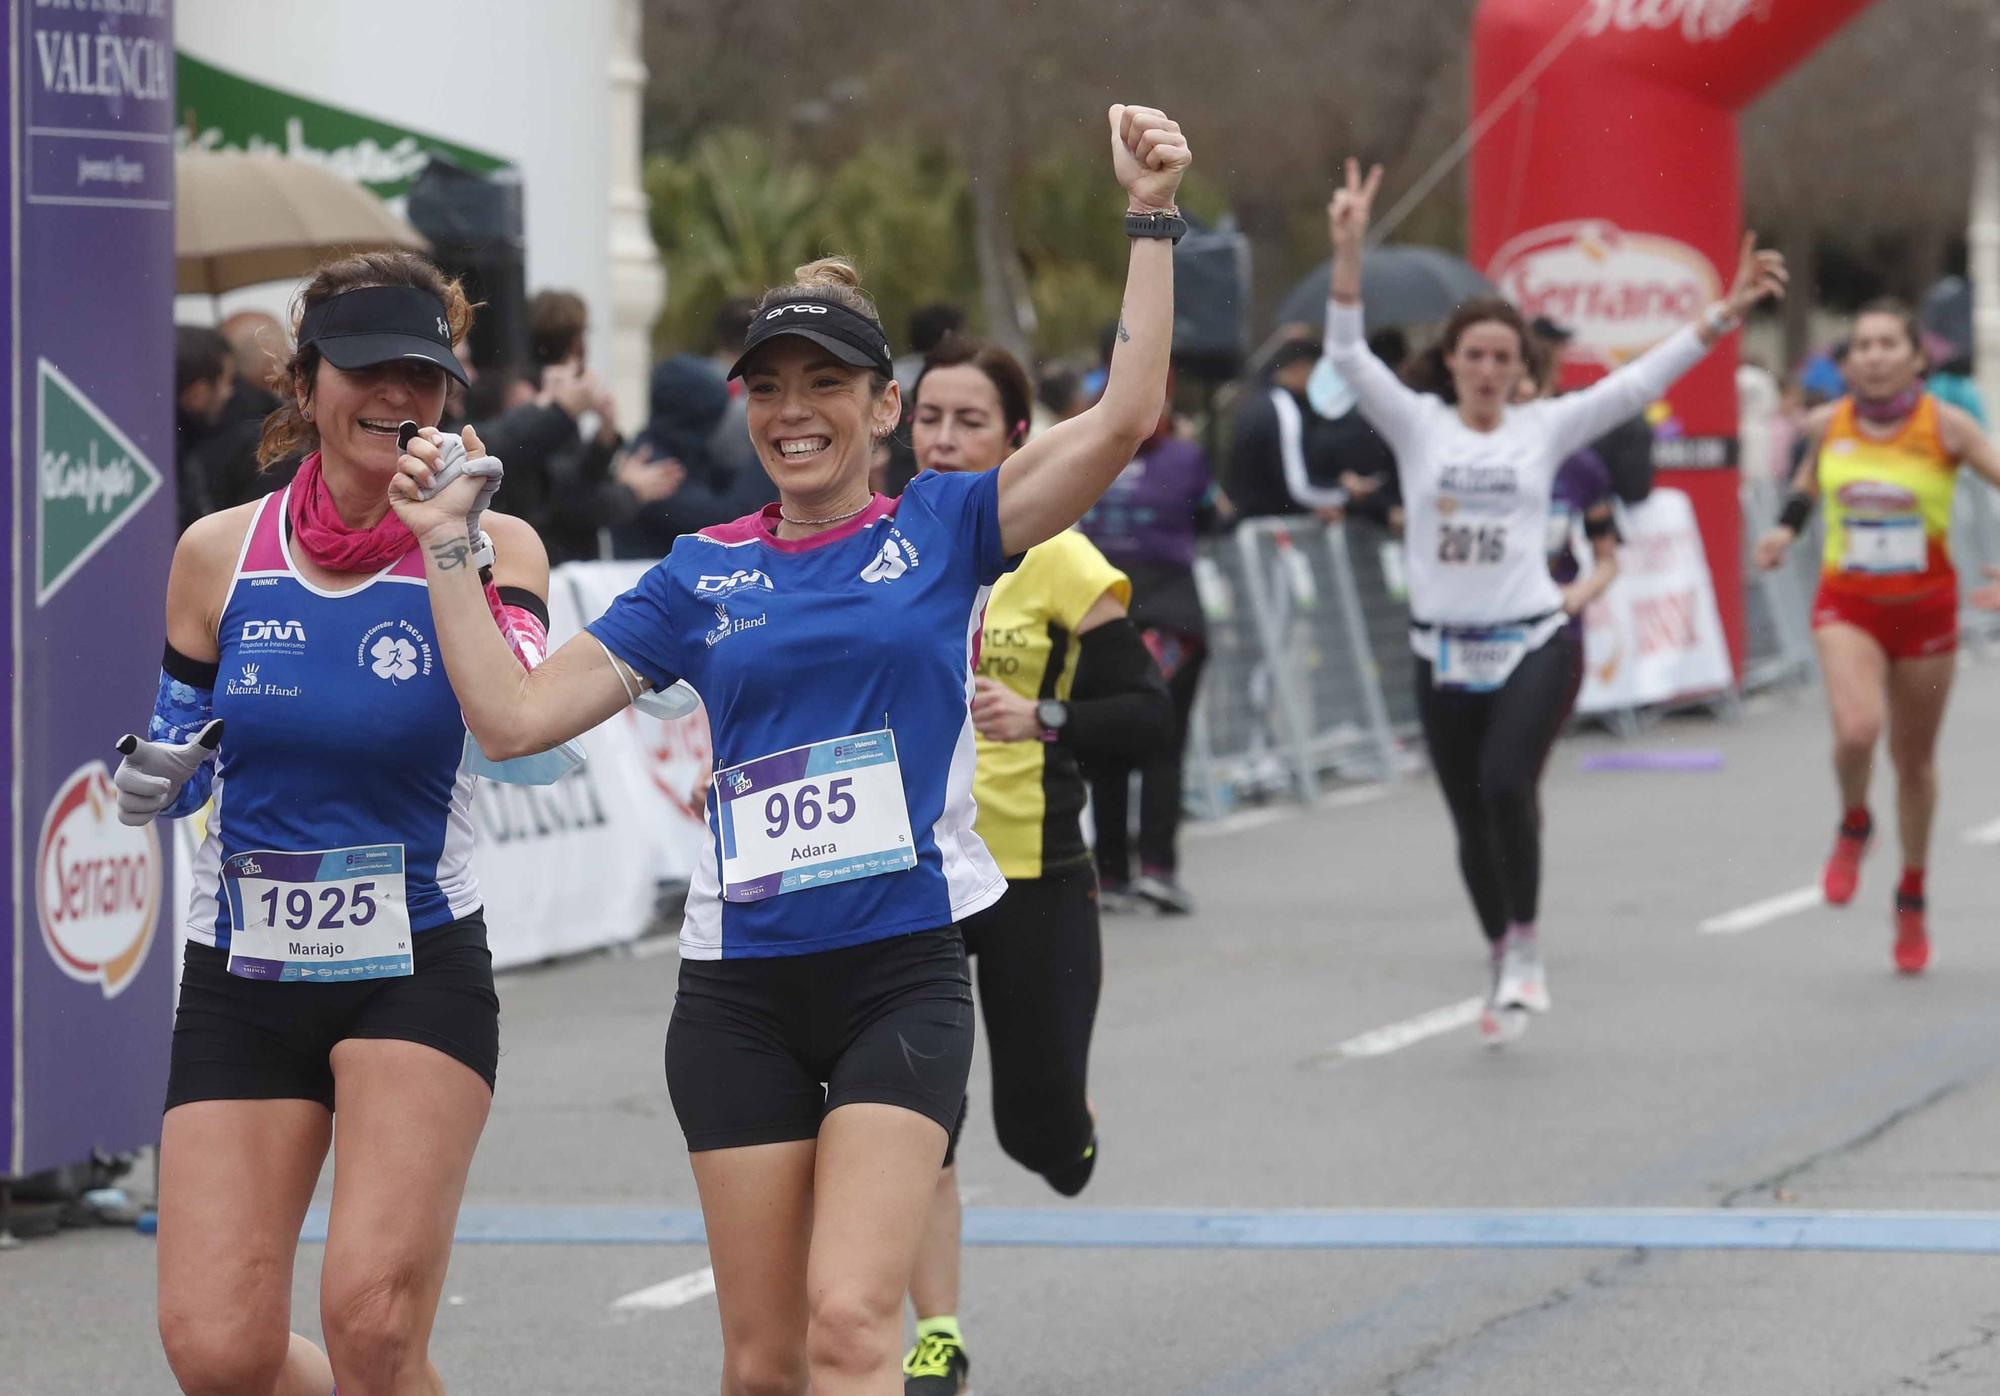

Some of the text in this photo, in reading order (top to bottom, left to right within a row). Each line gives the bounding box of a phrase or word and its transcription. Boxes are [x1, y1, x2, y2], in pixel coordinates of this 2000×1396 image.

[766, 305, 827, 320] orca
[900, 538, 919, 567] Milán
[251, 578, 279, 587] RUNNEK
[734, 613, 766, 632] Hand
[399, 619, 424, 642] Paco
[420, 643, 433, 676] Milán
[226, 684, 299, 697] Natural Hand
[736, 779, 751, 793] FEM
[765, 777, 857, 839] 965
[898, 834, 905, 842] S
[790, 842, 838, 862] Adara
[243, 866, 261, 874] FEM
[53, 836, 147, 922] Serrano
[260, 882, 377, 931] 1925
[288, 942, 344, 958] Mariajo
